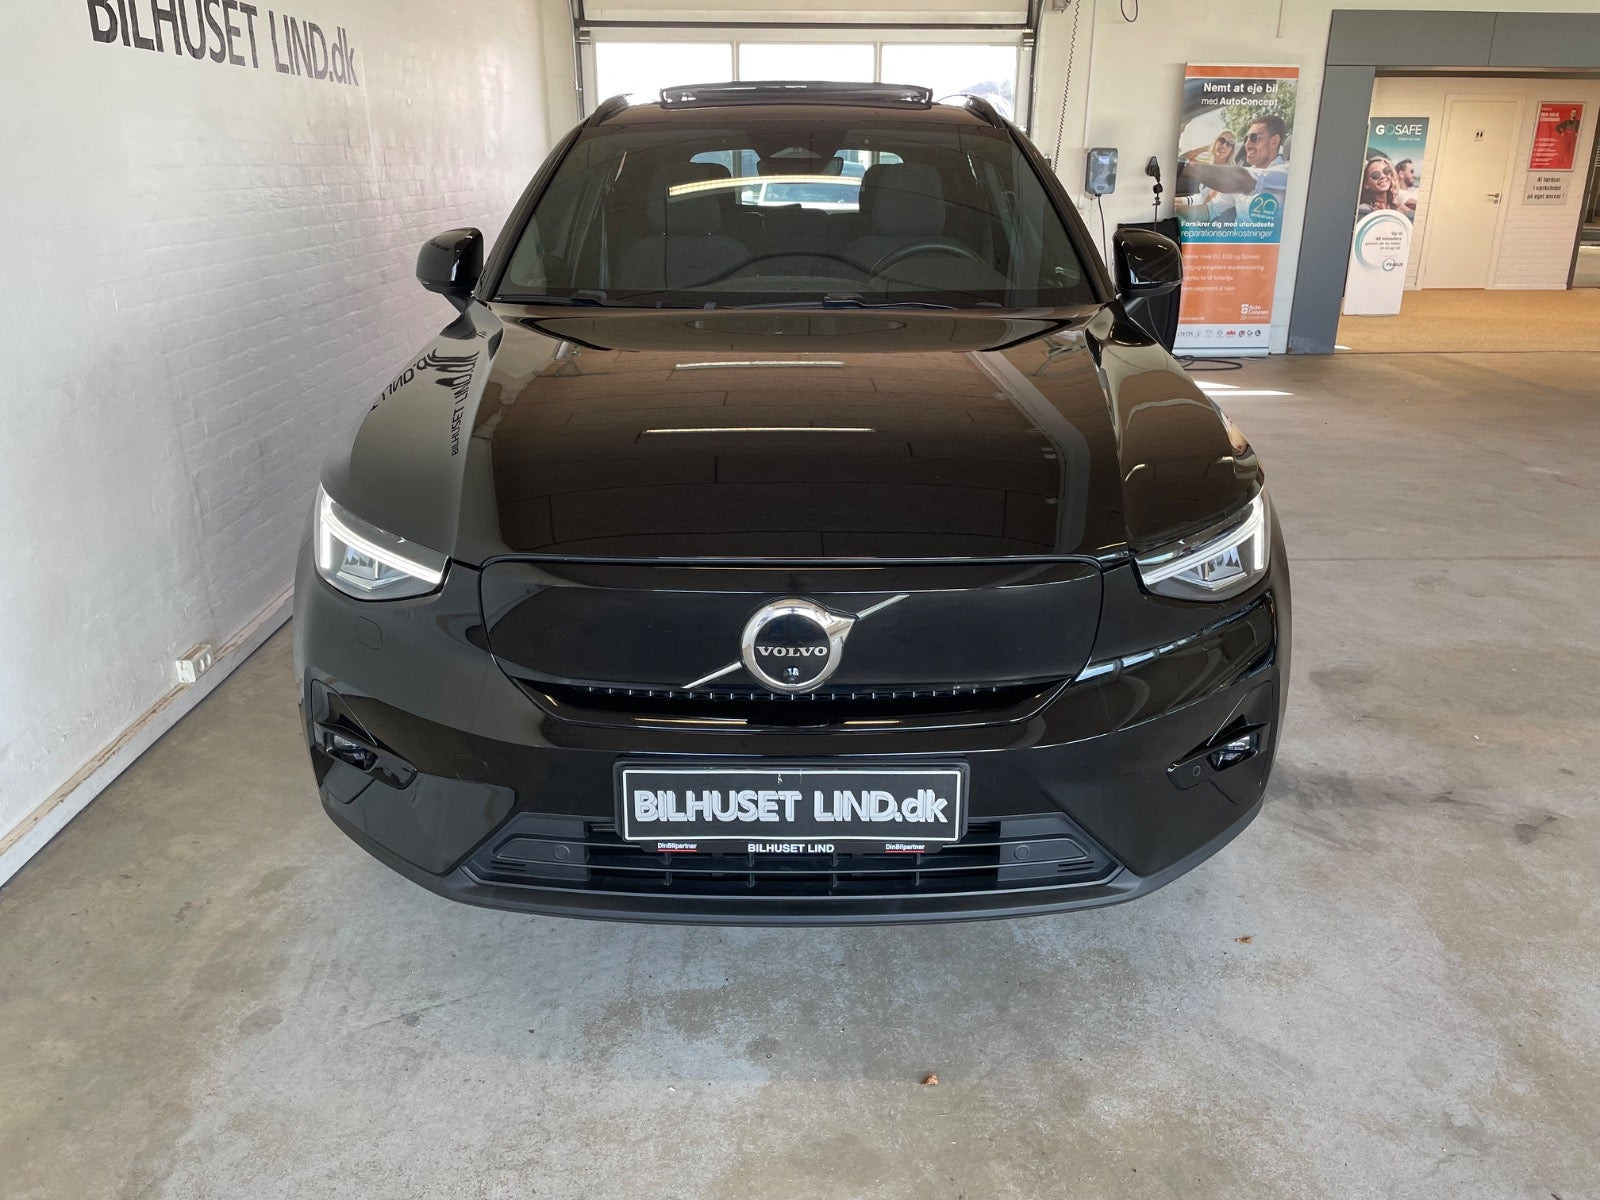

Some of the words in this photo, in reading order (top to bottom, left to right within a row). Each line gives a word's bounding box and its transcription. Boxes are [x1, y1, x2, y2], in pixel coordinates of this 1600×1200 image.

[268, 10, 359, 86] LIND.dk
[1203, 82, 1231, 93] Nemt
[1233, 84, 1245, 93] at
[1247, 83, 1263, 94] eje
[1265, 83, 1279, 93] bil
[1219, 97, 1278, 107] AutoConcept
[1375, 124, 1422, 135] GOSAFE
[1211, 221, 1222, 229] dig
[1182, 229, 1273, 239] reparationsomkostninger
[756, 646, 828, 657] VOLVO
[633, 790, 803, 822] BILHUSET
[813, 789, 949, 823] LIND.dk
[657, 842, 697, 851] DinBilpartner
[747, 843, 804, 853] BILHUSET
[807, 844, 835, 853] LIND
[885, 843, 925, 852] DinBilpartner
